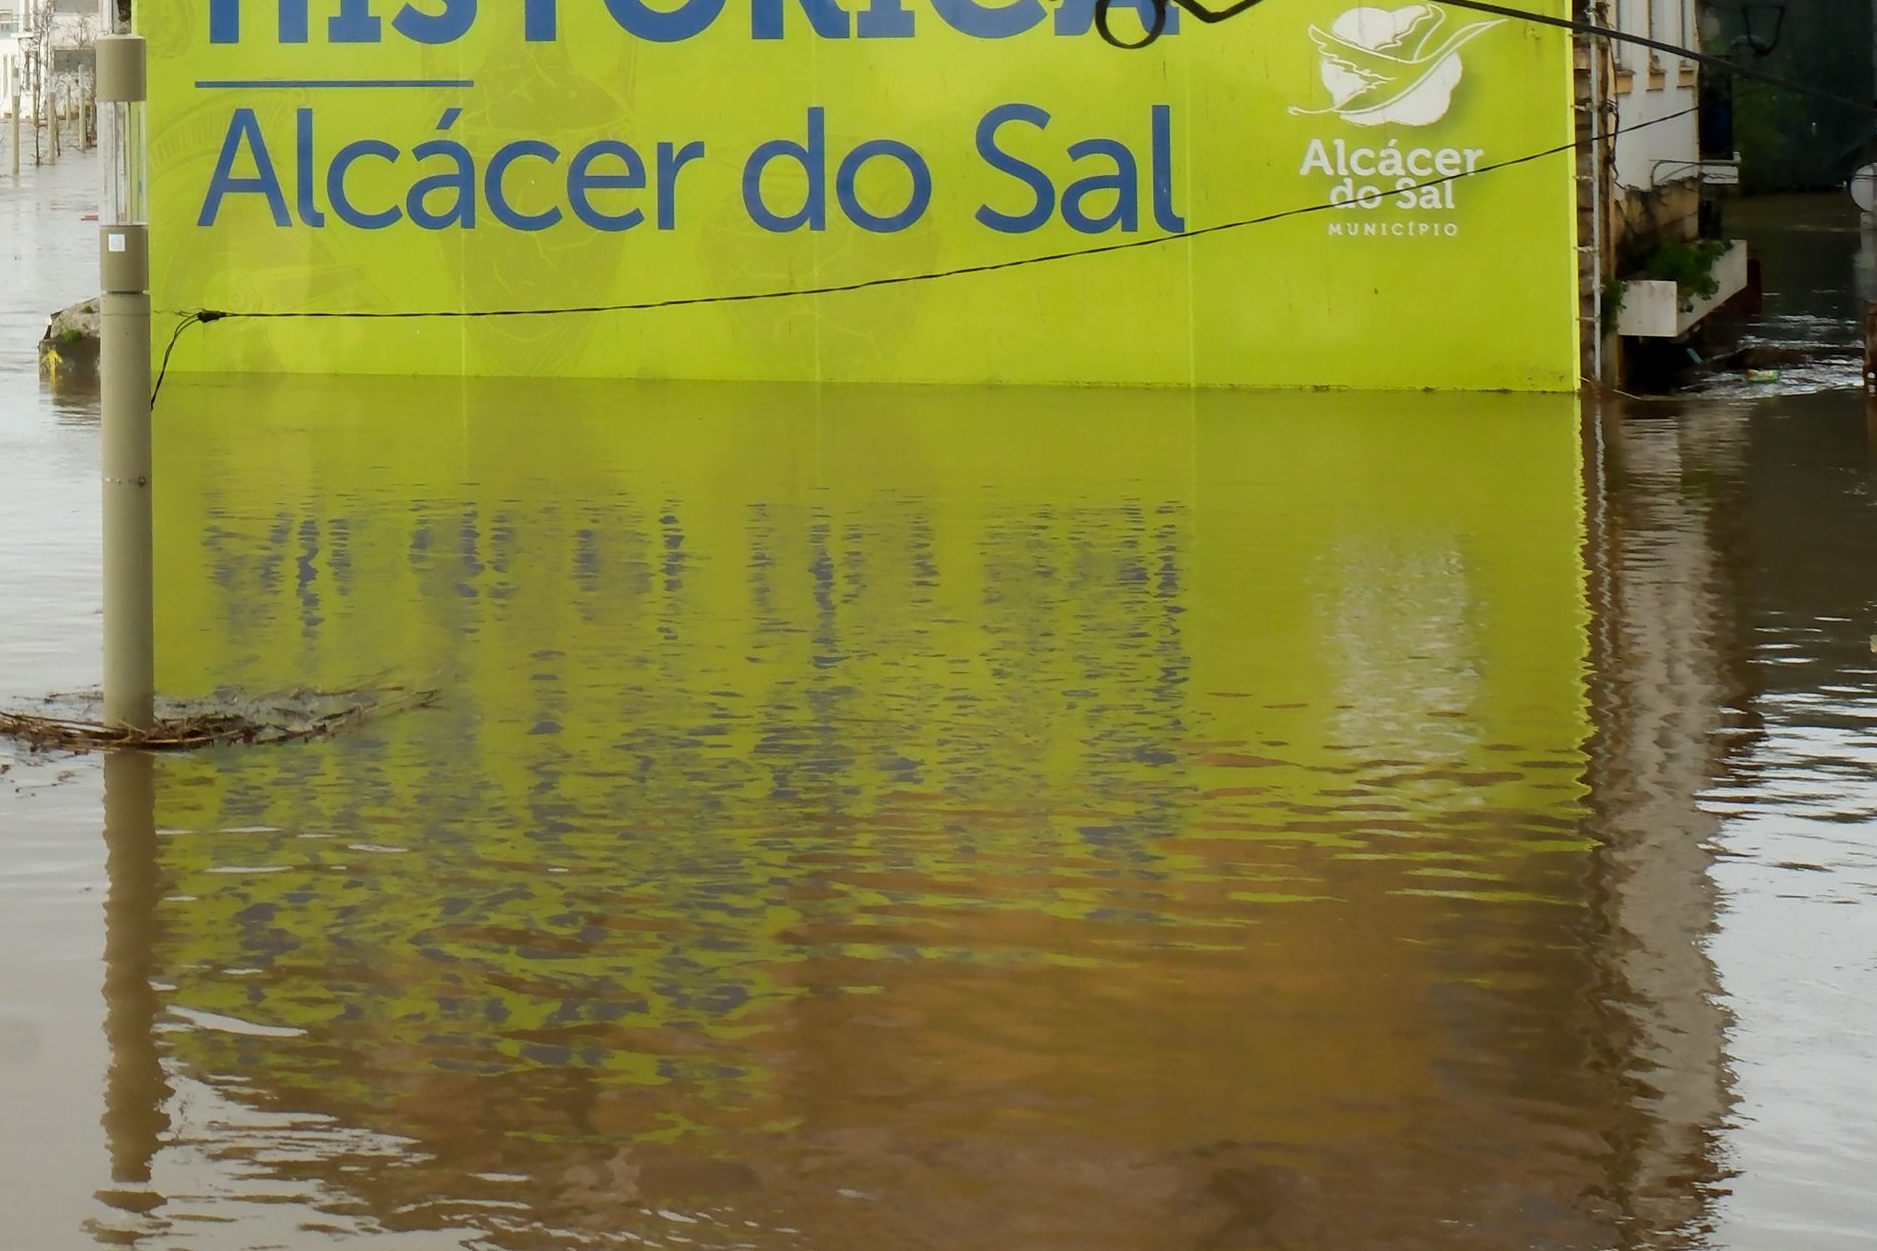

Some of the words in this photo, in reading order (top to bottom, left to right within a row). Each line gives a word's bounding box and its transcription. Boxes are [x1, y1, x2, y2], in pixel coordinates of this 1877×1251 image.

[197, 107, 705, 231] Alcácer
[742, 107, 932, 233] do
[974, 103, 1185, 234] Sal
[1299, 138, 1484, 177] Alcácer
[1329, 177, 1383, 209] do
[1395, 177, 1456, 209] Sal
[1328, 221, 1458, 236] MUNICÍPIO
